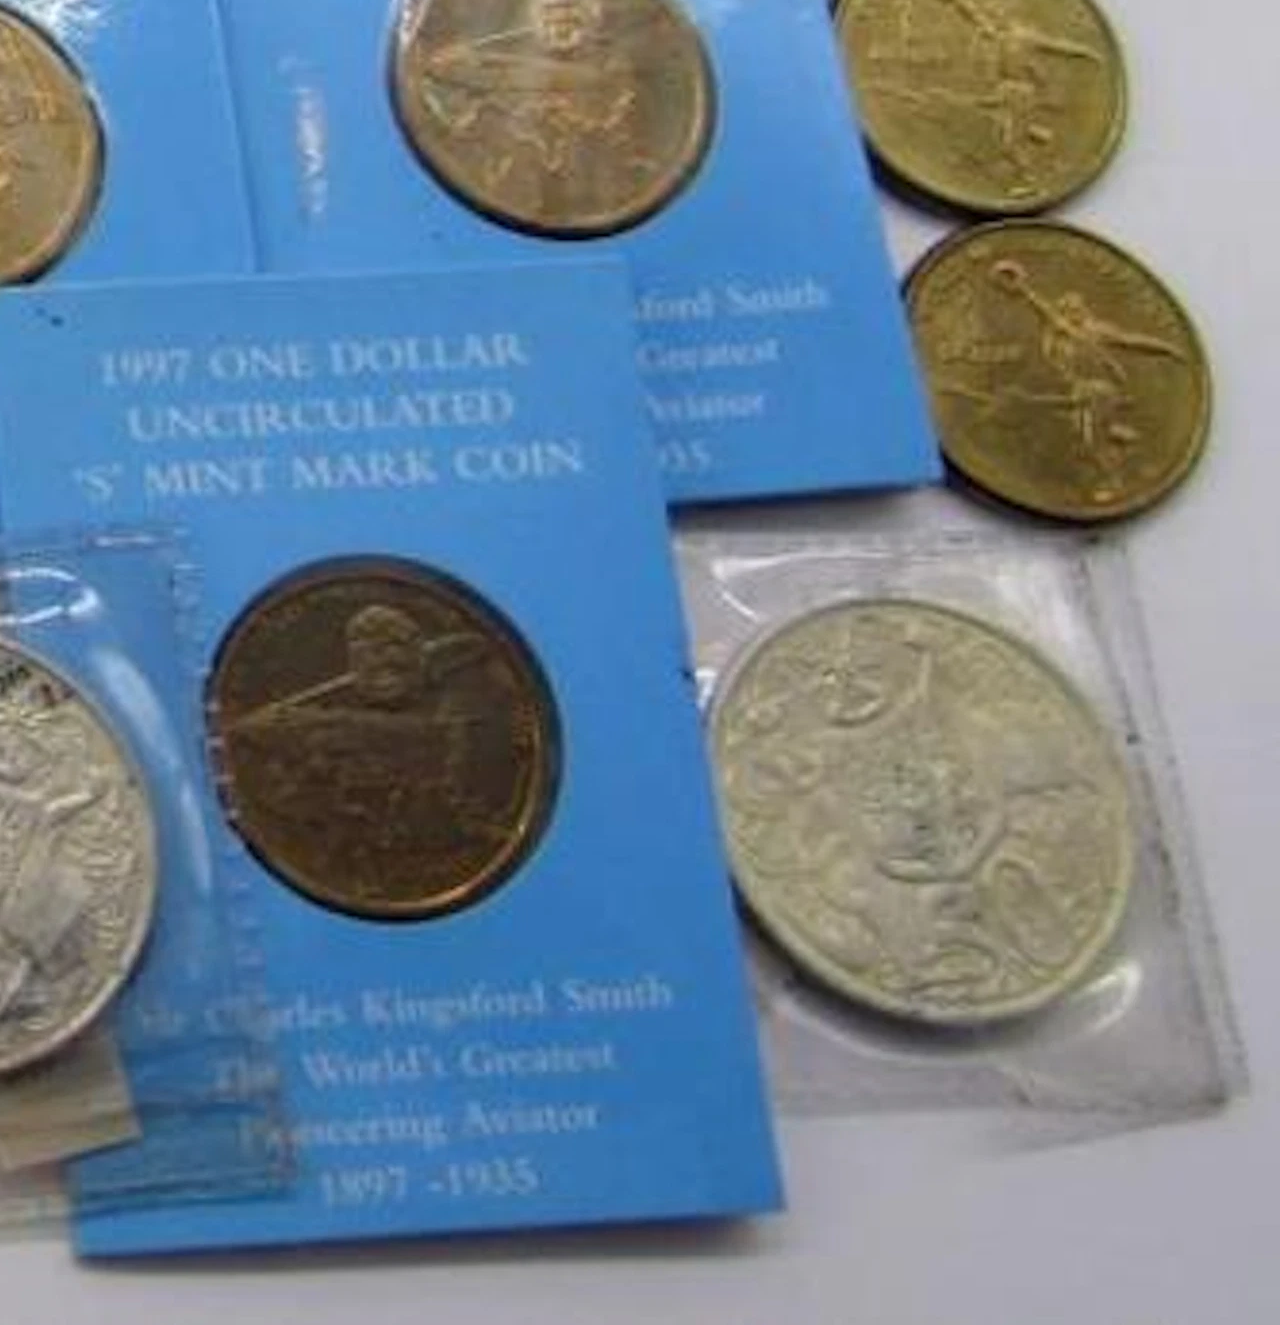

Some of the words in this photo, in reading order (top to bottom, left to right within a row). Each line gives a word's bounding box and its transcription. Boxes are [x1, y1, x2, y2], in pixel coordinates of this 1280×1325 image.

[100, 348, 190, 387] 1997
[207, 341, 317, 380] ONE
[329, 332, 532, 375] DOLLAR
[126, 386, 516, 444] UNCIRCULATED
[144, 456, 266, 499] MINT
[290, 448, 438, 491] MARK
[452, 436, 586, 482] COIN
[359, 980, 547, 1028] Kingsford
[559, 972, 675, 1013] Smith
[300, 1042, 448, 1088] World's
[459, 1037, 619, 1077] Greatest
[461, 1098, 602, 1138] Aviator
[321, 1165, 408, 1204] 1897
[428, 1156, 542, 1196] -1935
